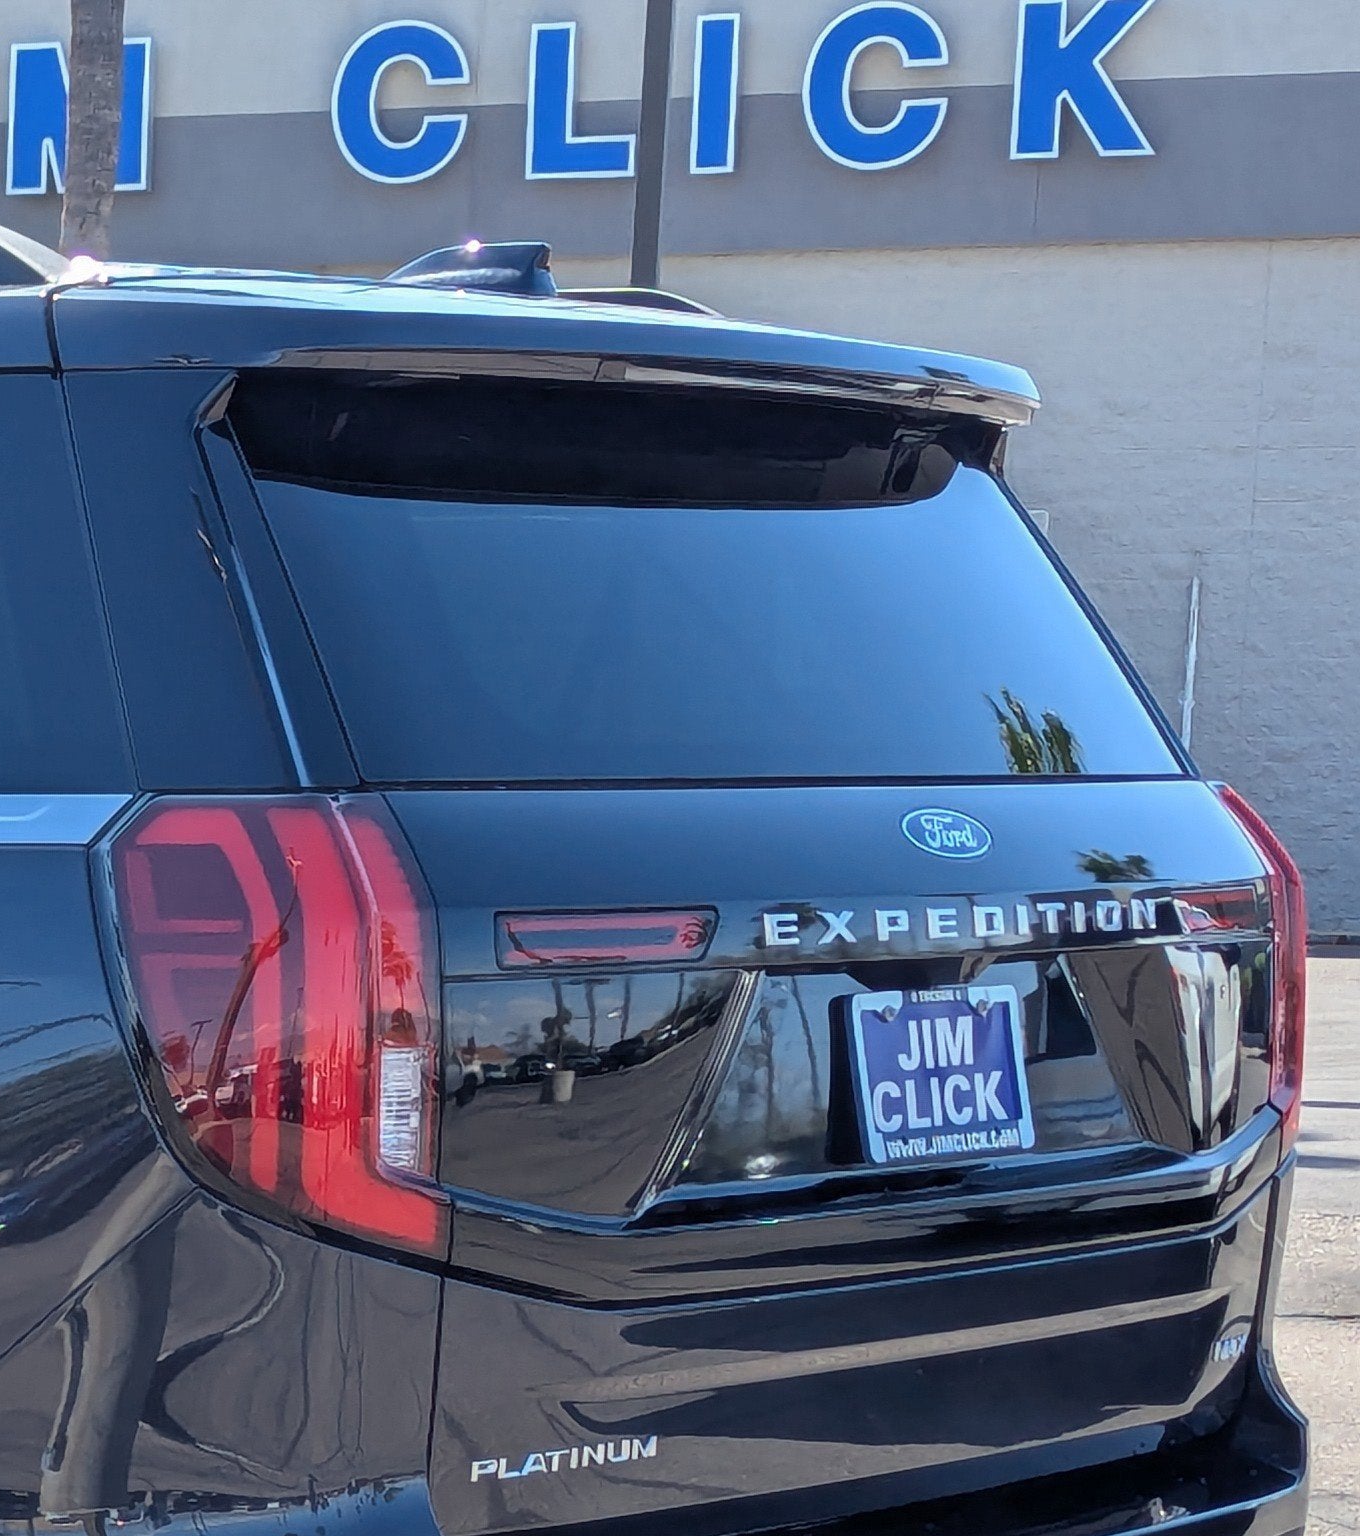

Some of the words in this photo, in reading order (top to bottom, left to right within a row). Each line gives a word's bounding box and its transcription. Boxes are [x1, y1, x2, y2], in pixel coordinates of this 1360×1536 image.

[331, 0, 1156, 185] CLICK
[919, 814, 978, 850] Ford
[763, 897, 1158, 947] EXPEDITION
[897, 1015, 974, 1071] JIM
[872, 1070, 1009, 1133] CLICK
[470, 1435, 658, 1483] PLATINUM
